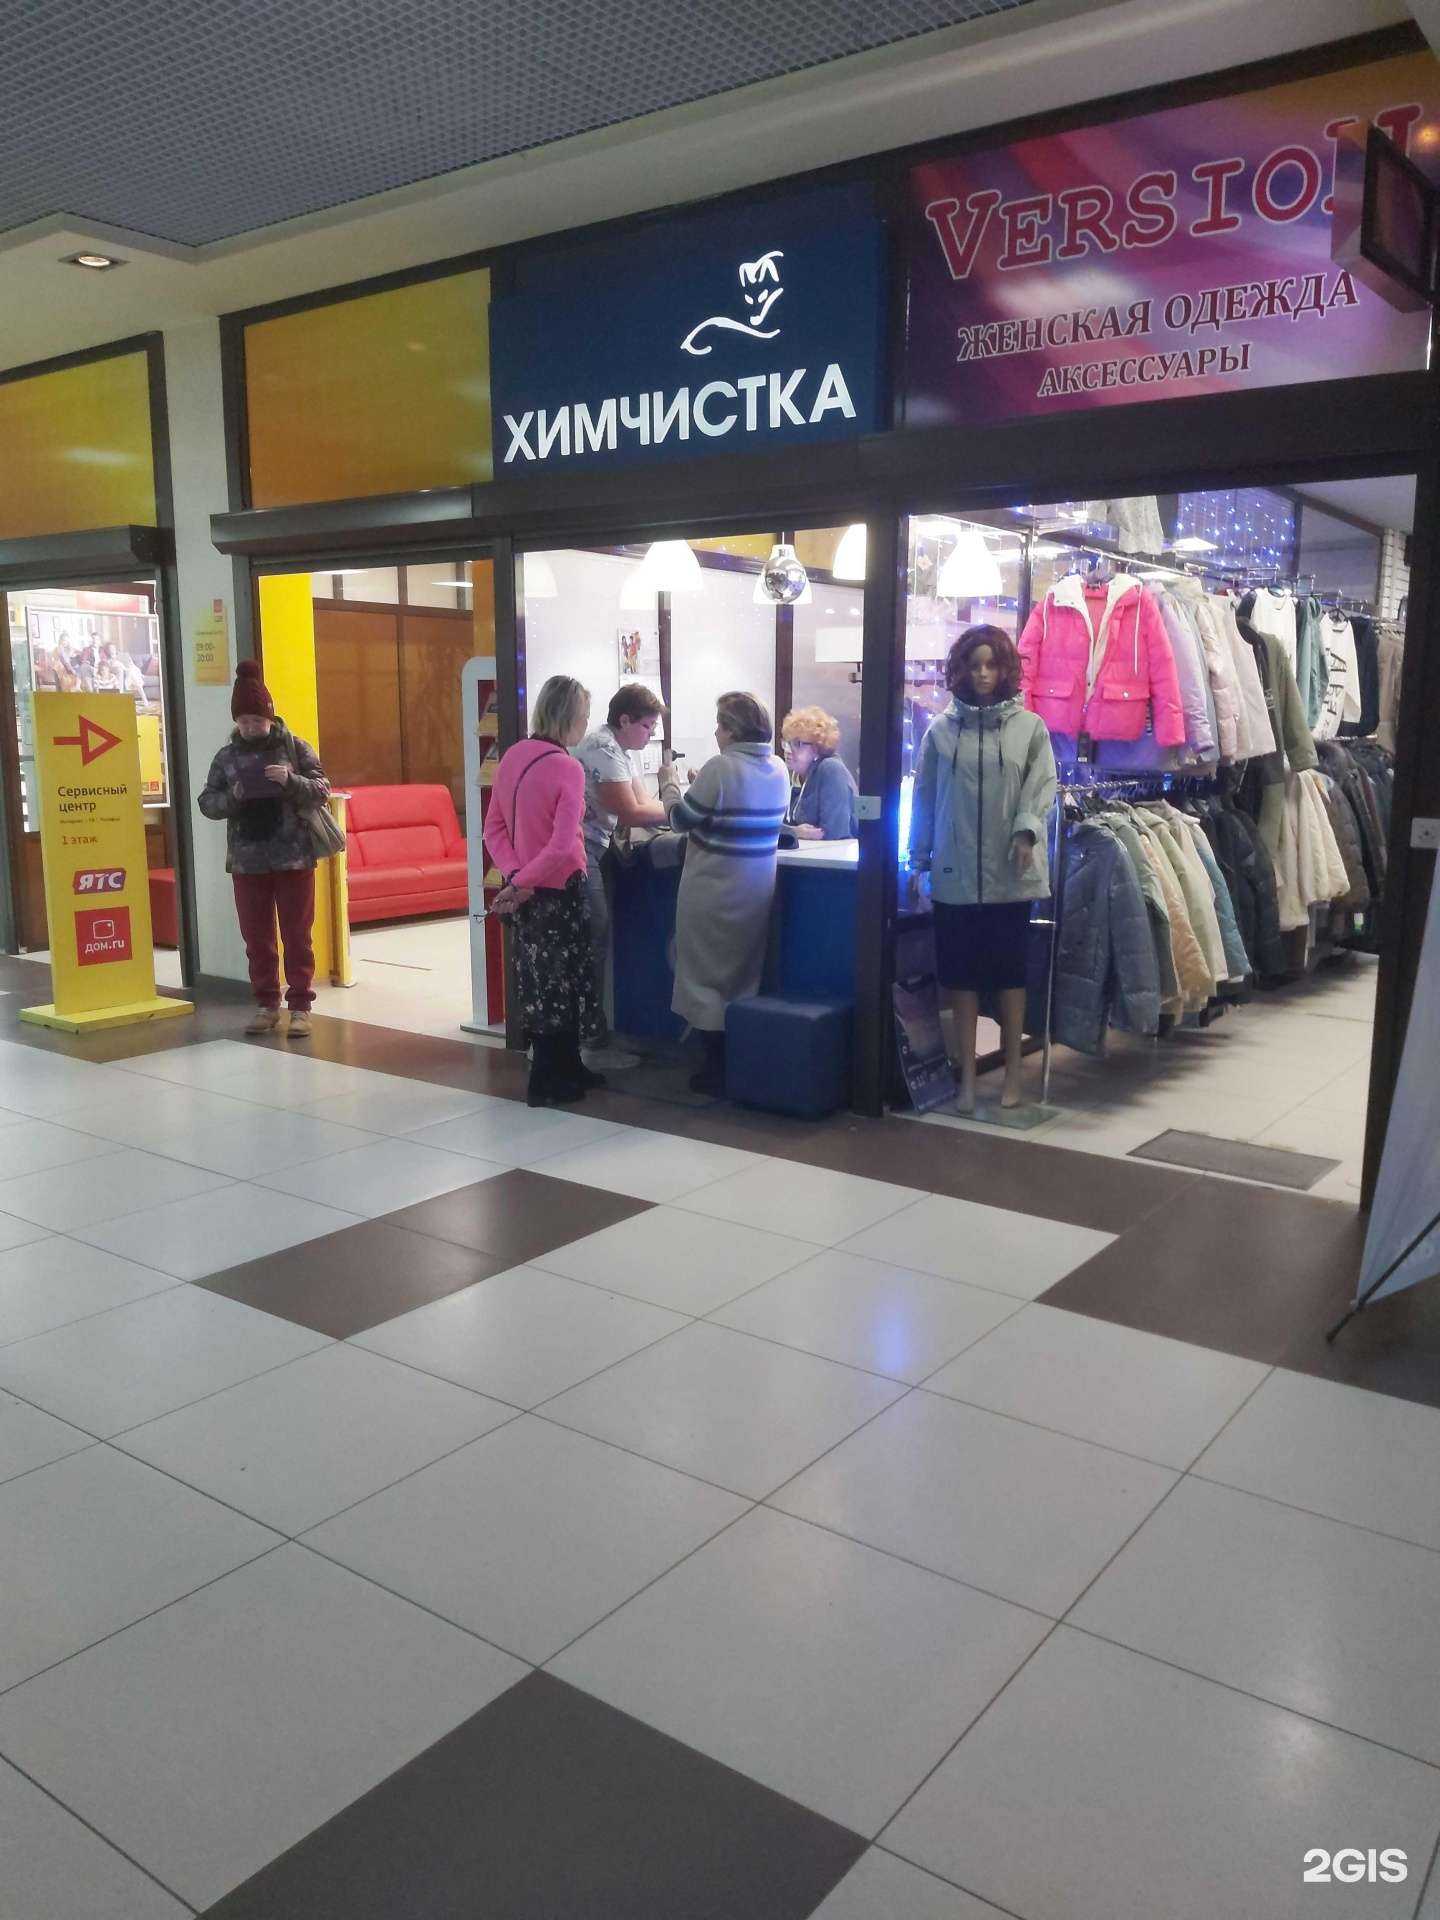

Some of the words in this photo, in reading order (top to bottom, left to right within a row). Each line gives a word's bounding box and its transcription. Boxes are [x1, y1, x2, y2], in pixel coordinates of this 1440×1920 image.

[956, 298, 1153, 362] ЖЕНСКАЯ
[1164, 269, 1360, 335] ОДЕЖДА
[1036, 342, 1252, 398] АКСЕССУАРЫ
[503, 362, 857, 464] ХИМЧИСТКА
[57, 783, 128, 799] Сервисный
[59, 802, 97, 814] центр
[71, 835, 98, 845] этаж
[78, 871, 123, 891] ЯТС
